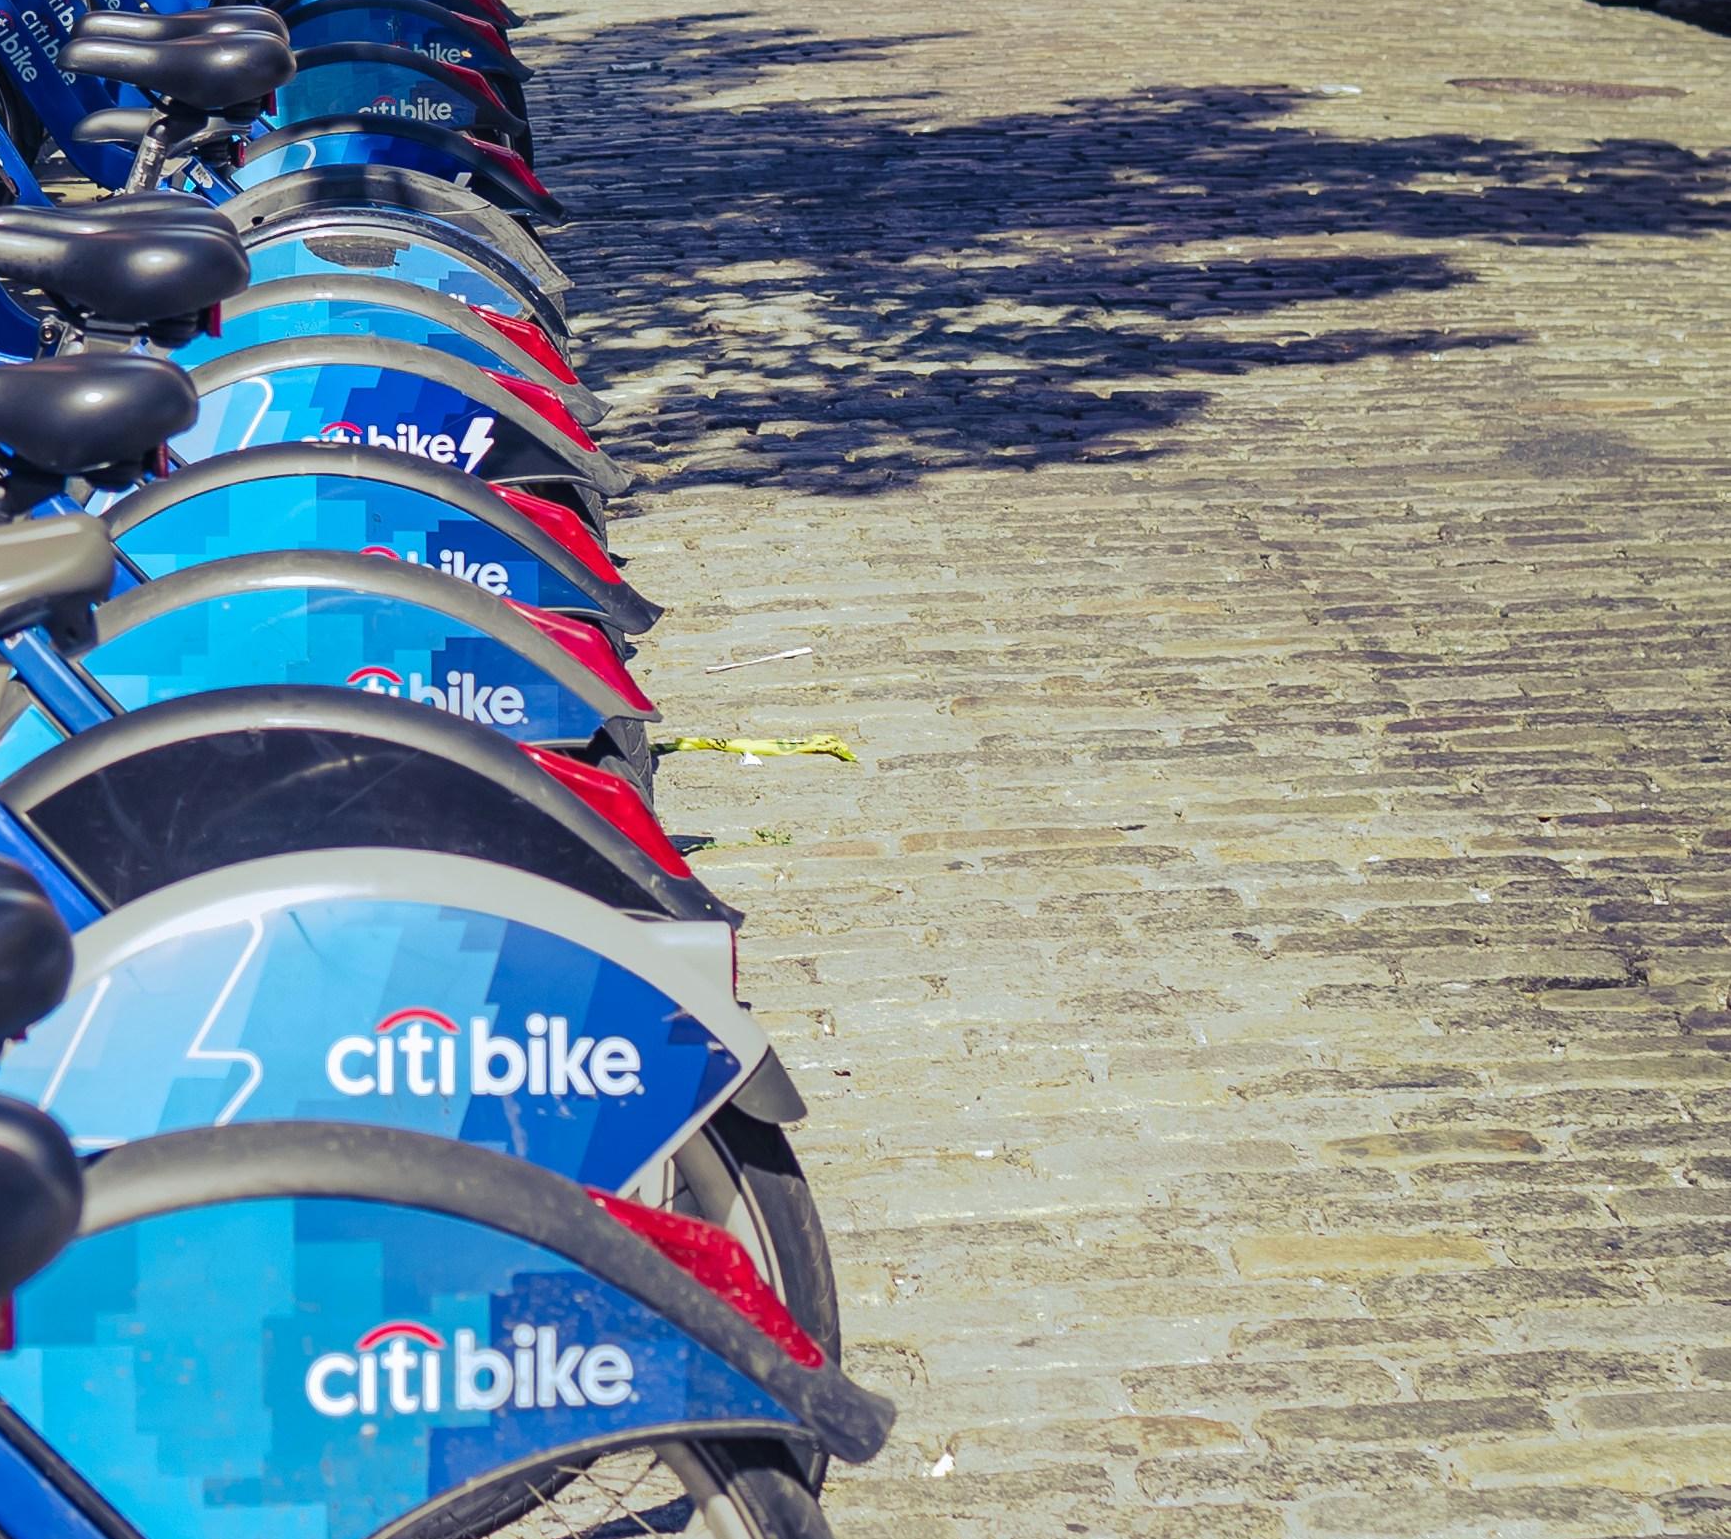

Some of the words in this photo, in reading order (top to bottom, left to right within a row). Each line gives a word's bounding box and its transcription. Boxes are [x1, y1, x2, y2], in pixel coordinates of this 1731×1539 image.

[42, 38, 77, 85] be
[325, 1006, 462, 1098] citi
[469, 1012, 643, 1099] bike
[304, 1319, 448, 1419] citi
[454, 1321, 636, 1413] bike
